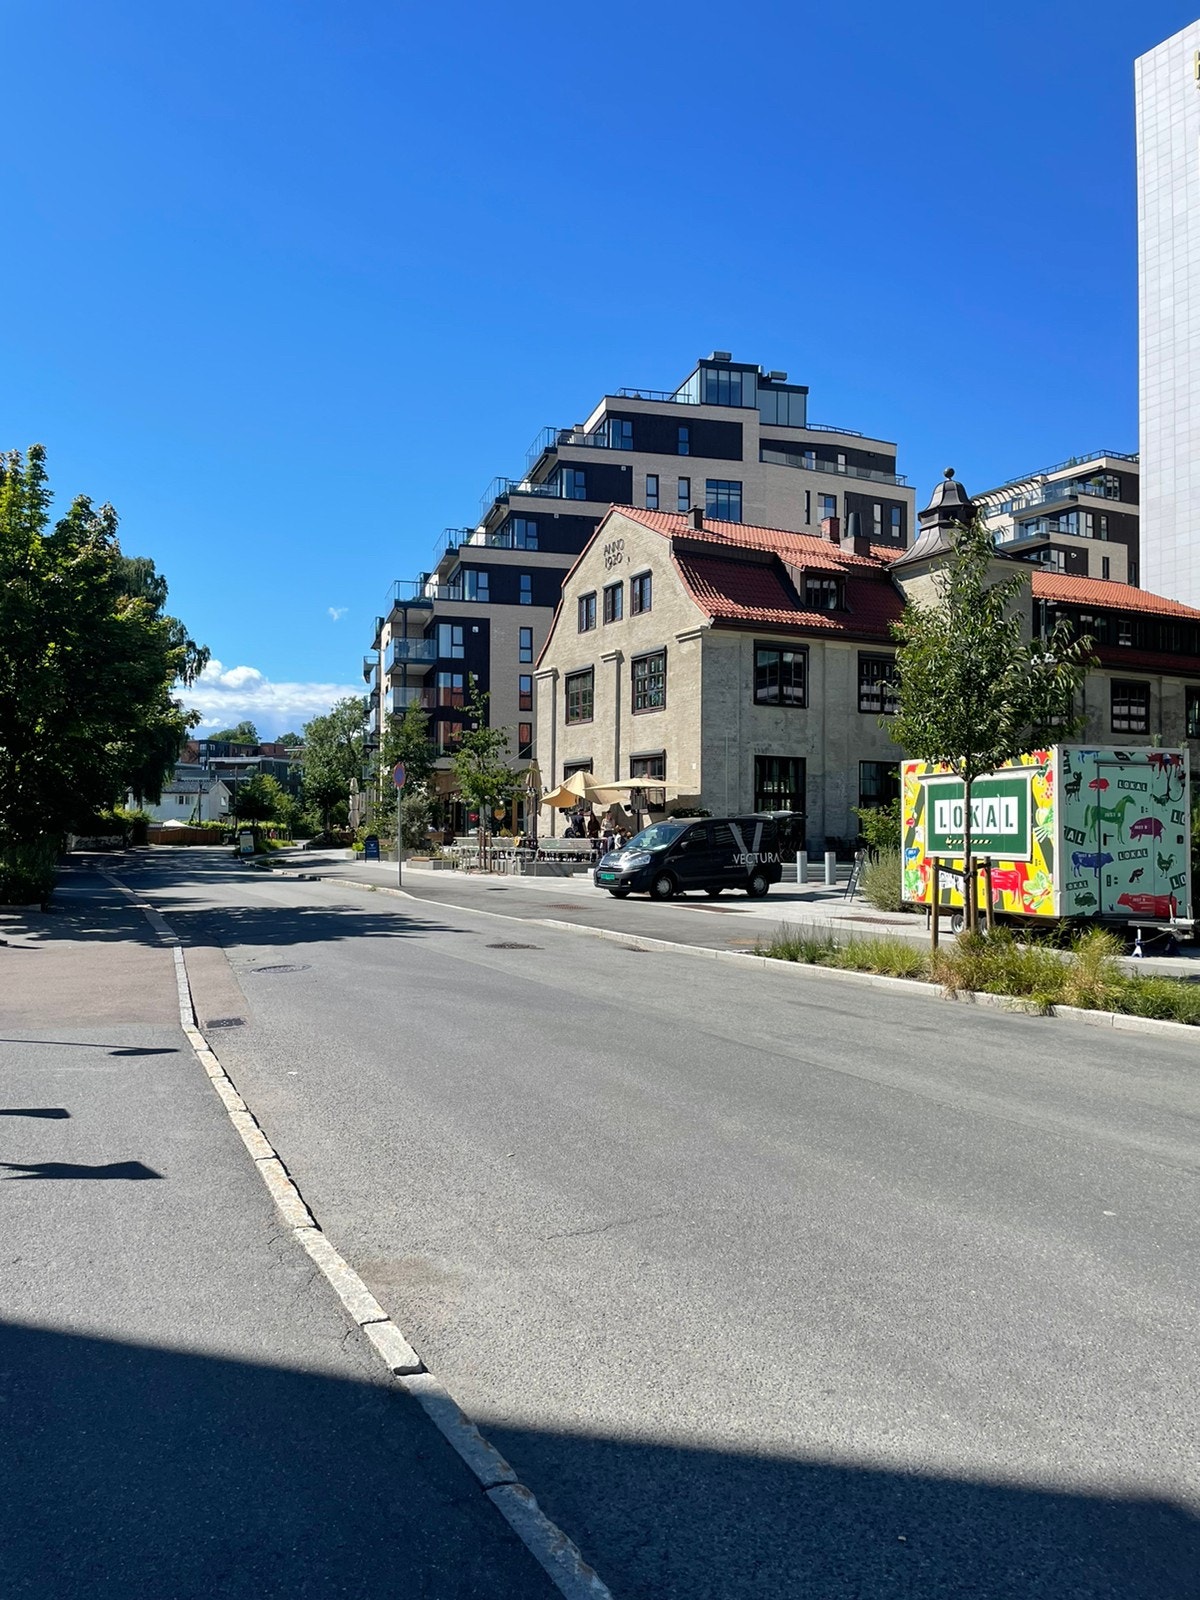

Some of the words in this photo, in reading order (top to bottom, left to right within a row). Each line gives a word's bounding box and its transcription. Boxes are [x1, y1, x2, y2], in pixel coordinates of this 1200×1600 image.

[604, 538, 625, 557] ANNO
[605, 552, 623, 570] 1920
[1119, 781, 1147, 791] LOKAL
[940, 804, 1013, 828] LOKAL
[733, 852, 780, 865] VECTURA
[1119, 850, 1148, 860] LOKAL
